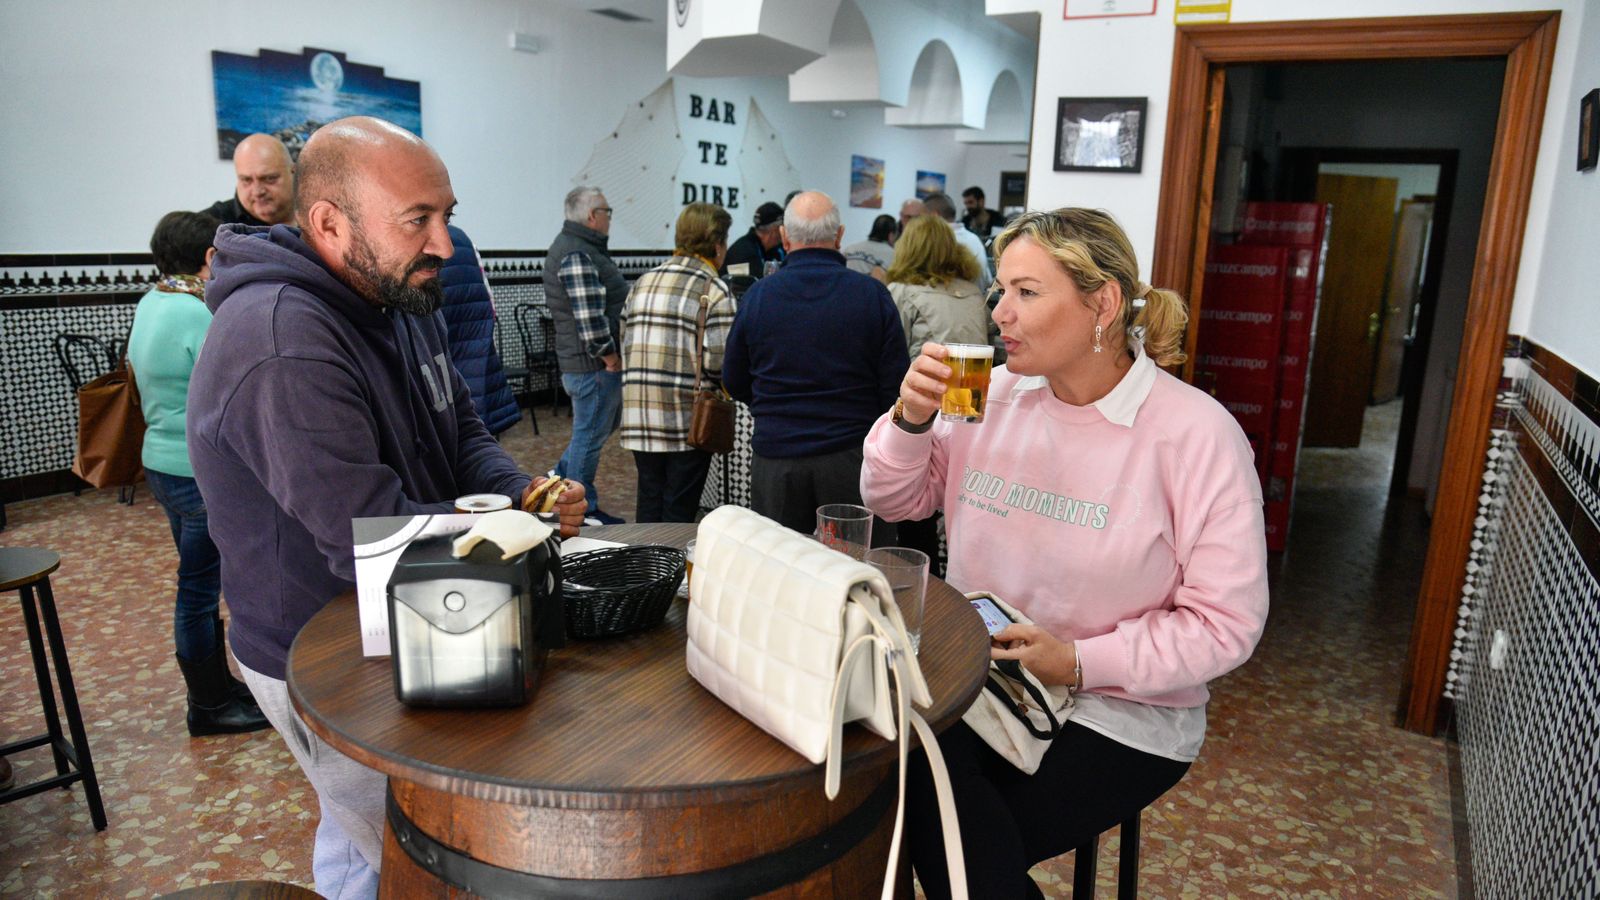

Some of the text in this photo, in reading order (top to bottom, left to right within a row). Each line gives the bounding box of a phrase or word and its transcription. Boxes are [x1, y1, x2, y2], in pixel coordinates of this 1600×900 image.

[690, 94, 736, 125] BAR
[698, 140, 728, 166] TE
[682, 182, 739, 209] DIRE
[976, 500, 986, 510] be
[987, 503, 1009, 518] lived
[1004, 482, 1109, 529] MOMENTS
